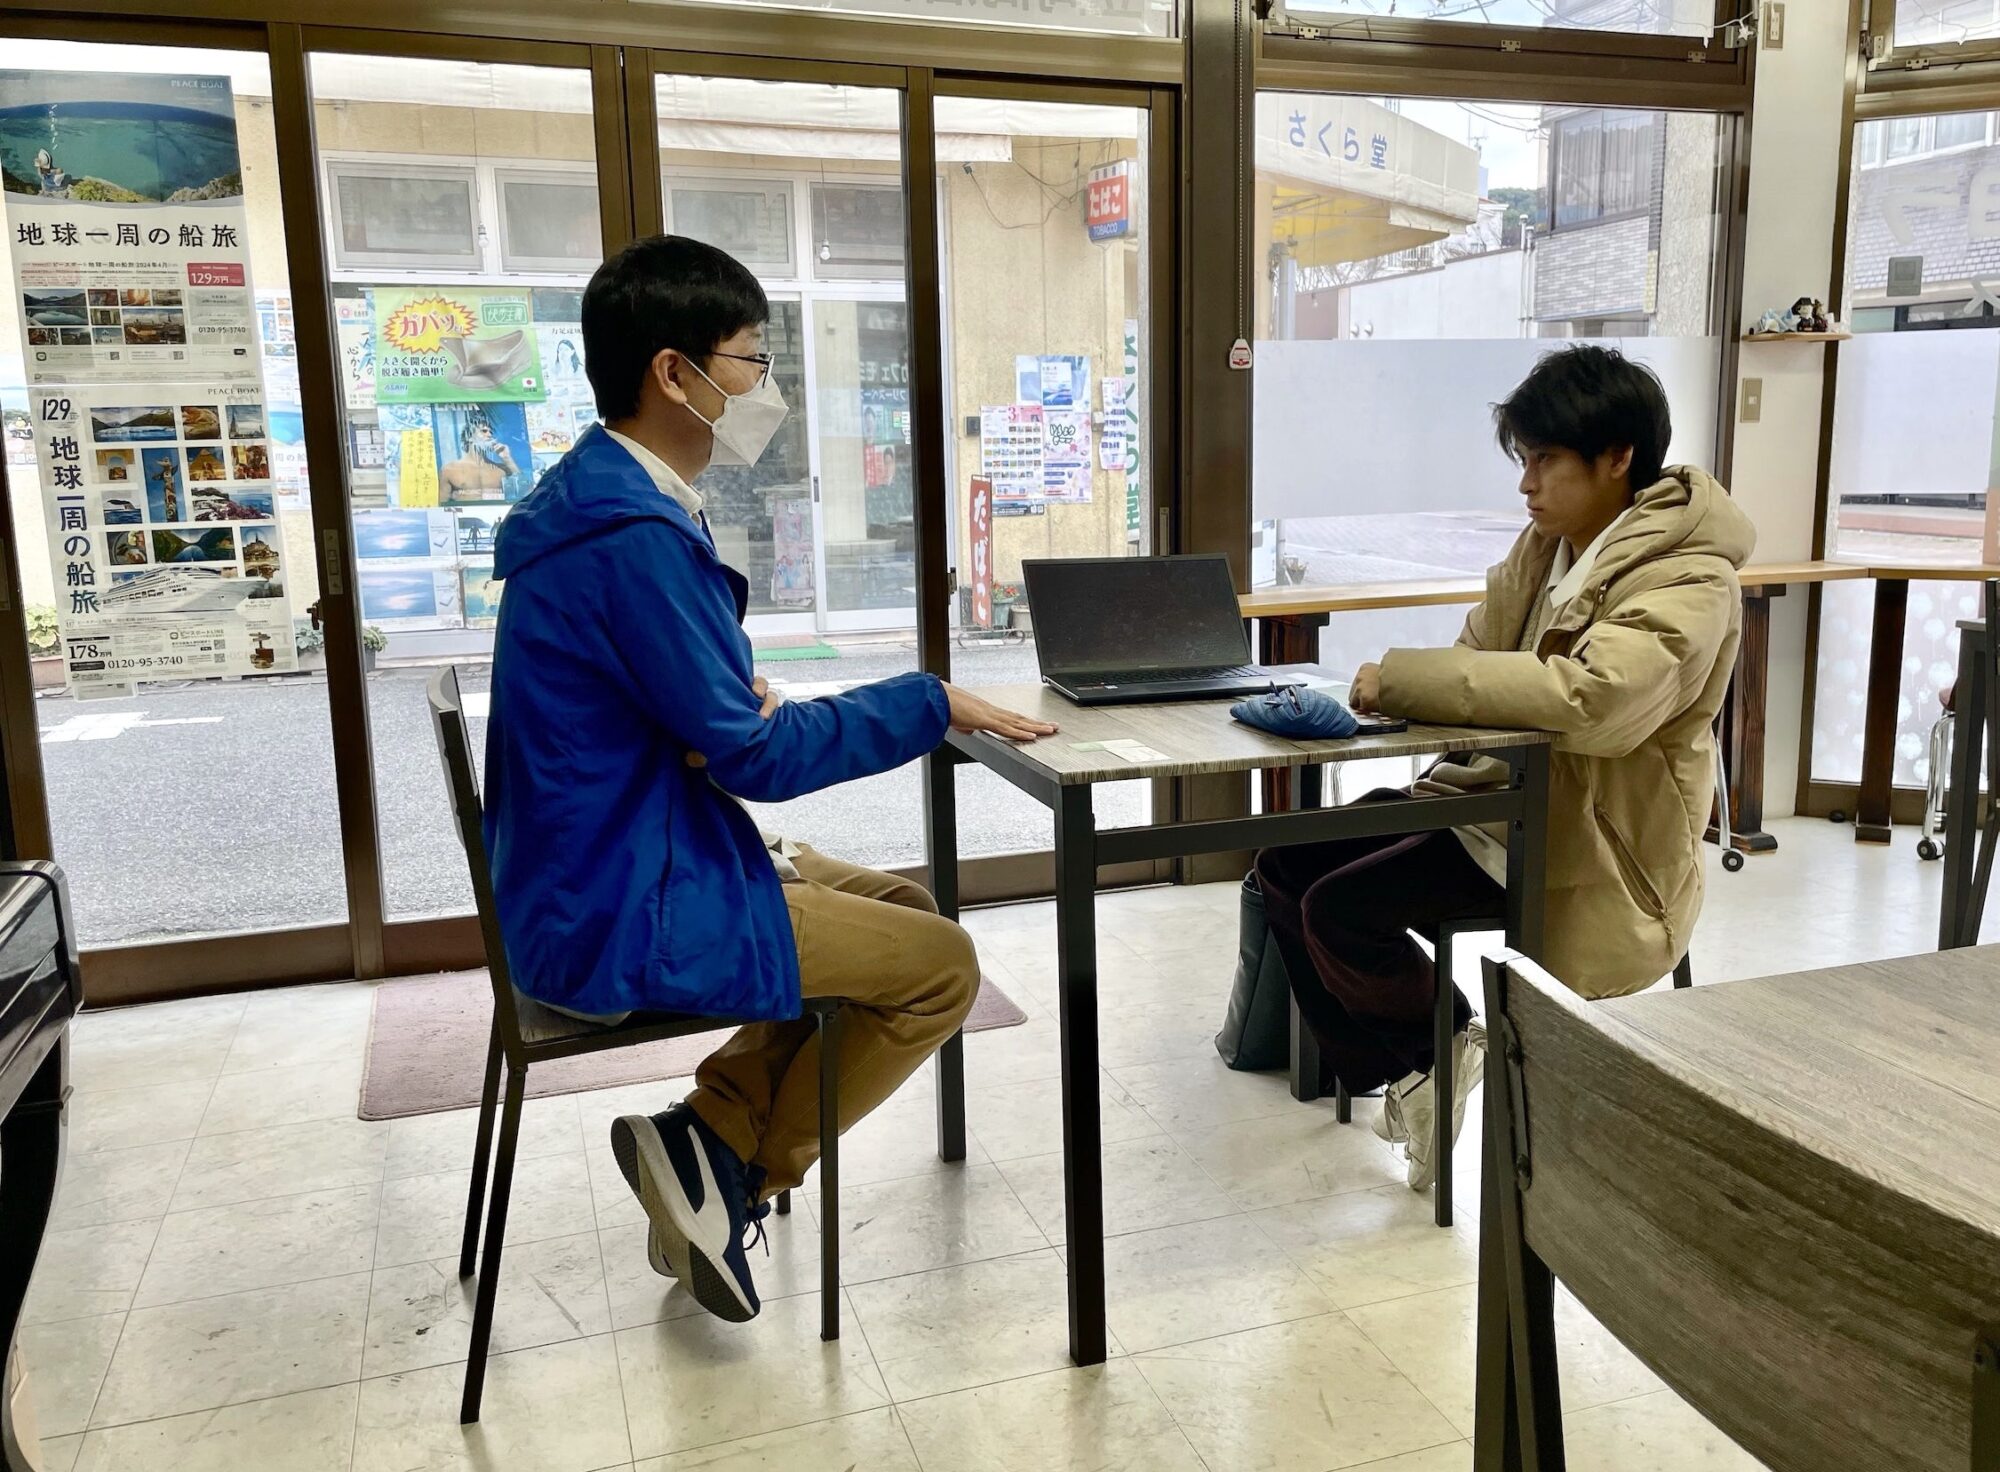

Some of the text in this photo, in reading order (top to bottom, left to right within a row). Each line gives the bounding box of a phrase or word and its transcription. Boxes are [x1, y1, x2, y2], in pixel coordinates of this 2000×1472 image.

[1288, 109, 1388, 170] さくら堂
[1089, 184, 1122, 218] たばこ
[17, 222, 239, 248] 地球一周の船旅
[1092, 222, 1118, 237] TOBACCO
[191, 272, 229, 285] 129万円
[382, 356, 448, 366] 大きく開くから
[381, 367, 445, 377] 脱ぎ履き簡単!
[42, 398, 71, 421] 129
[49, 436, 101, 615] 地球一周の船旅
[107, 655, 183, 670] 0120-95-3740
